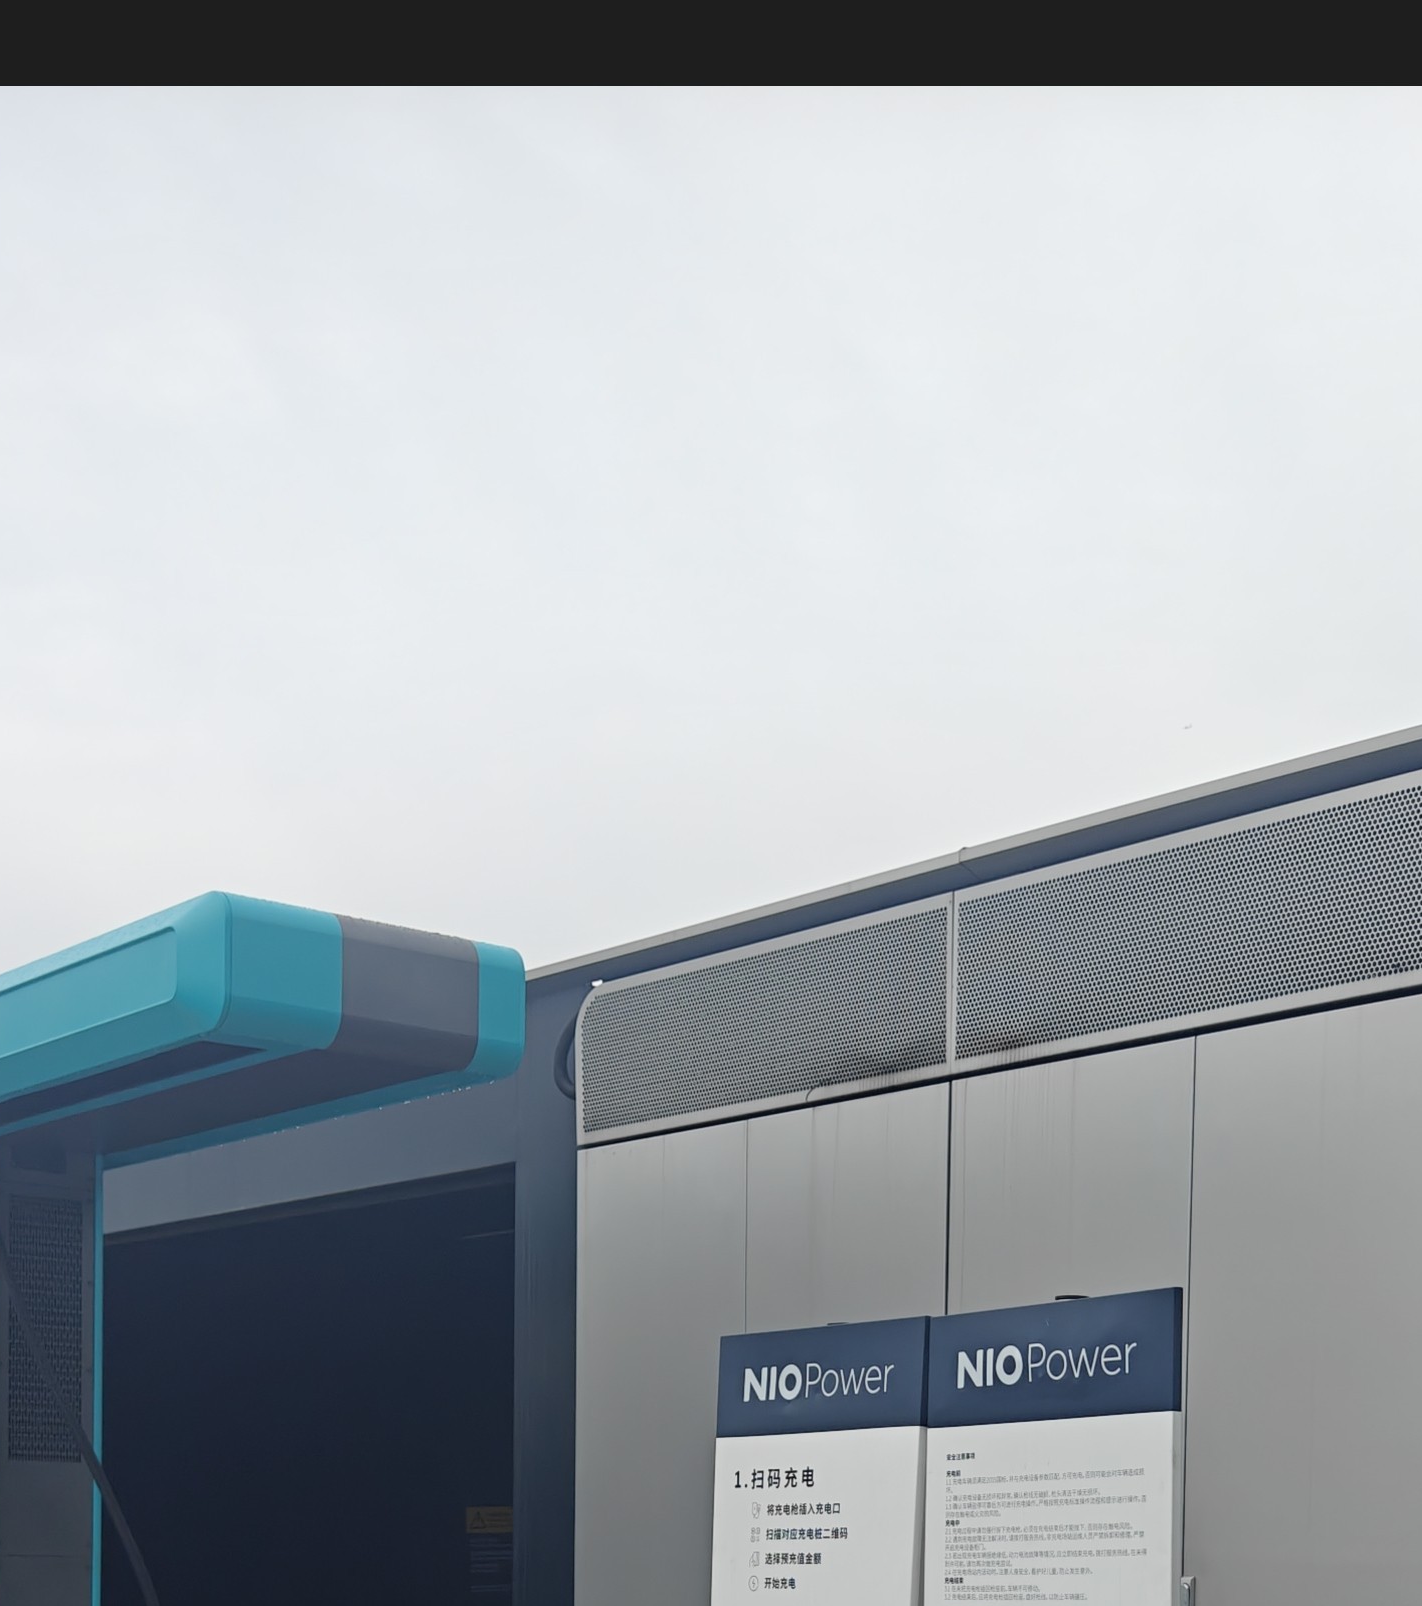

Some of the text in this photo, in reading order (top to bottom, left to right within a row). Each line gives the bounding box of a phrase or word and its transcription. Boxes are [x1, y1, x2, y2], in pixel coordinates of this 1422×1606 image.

[766, 1502, 841, 1516] 将充电枪插入充电口
[765, 1527, 848, 1540] 扫描对应充电桩二维码
[764, 1552, 822, 1565] 选择预充值金额
[763, 1577, 796, 1589] 开始充电
